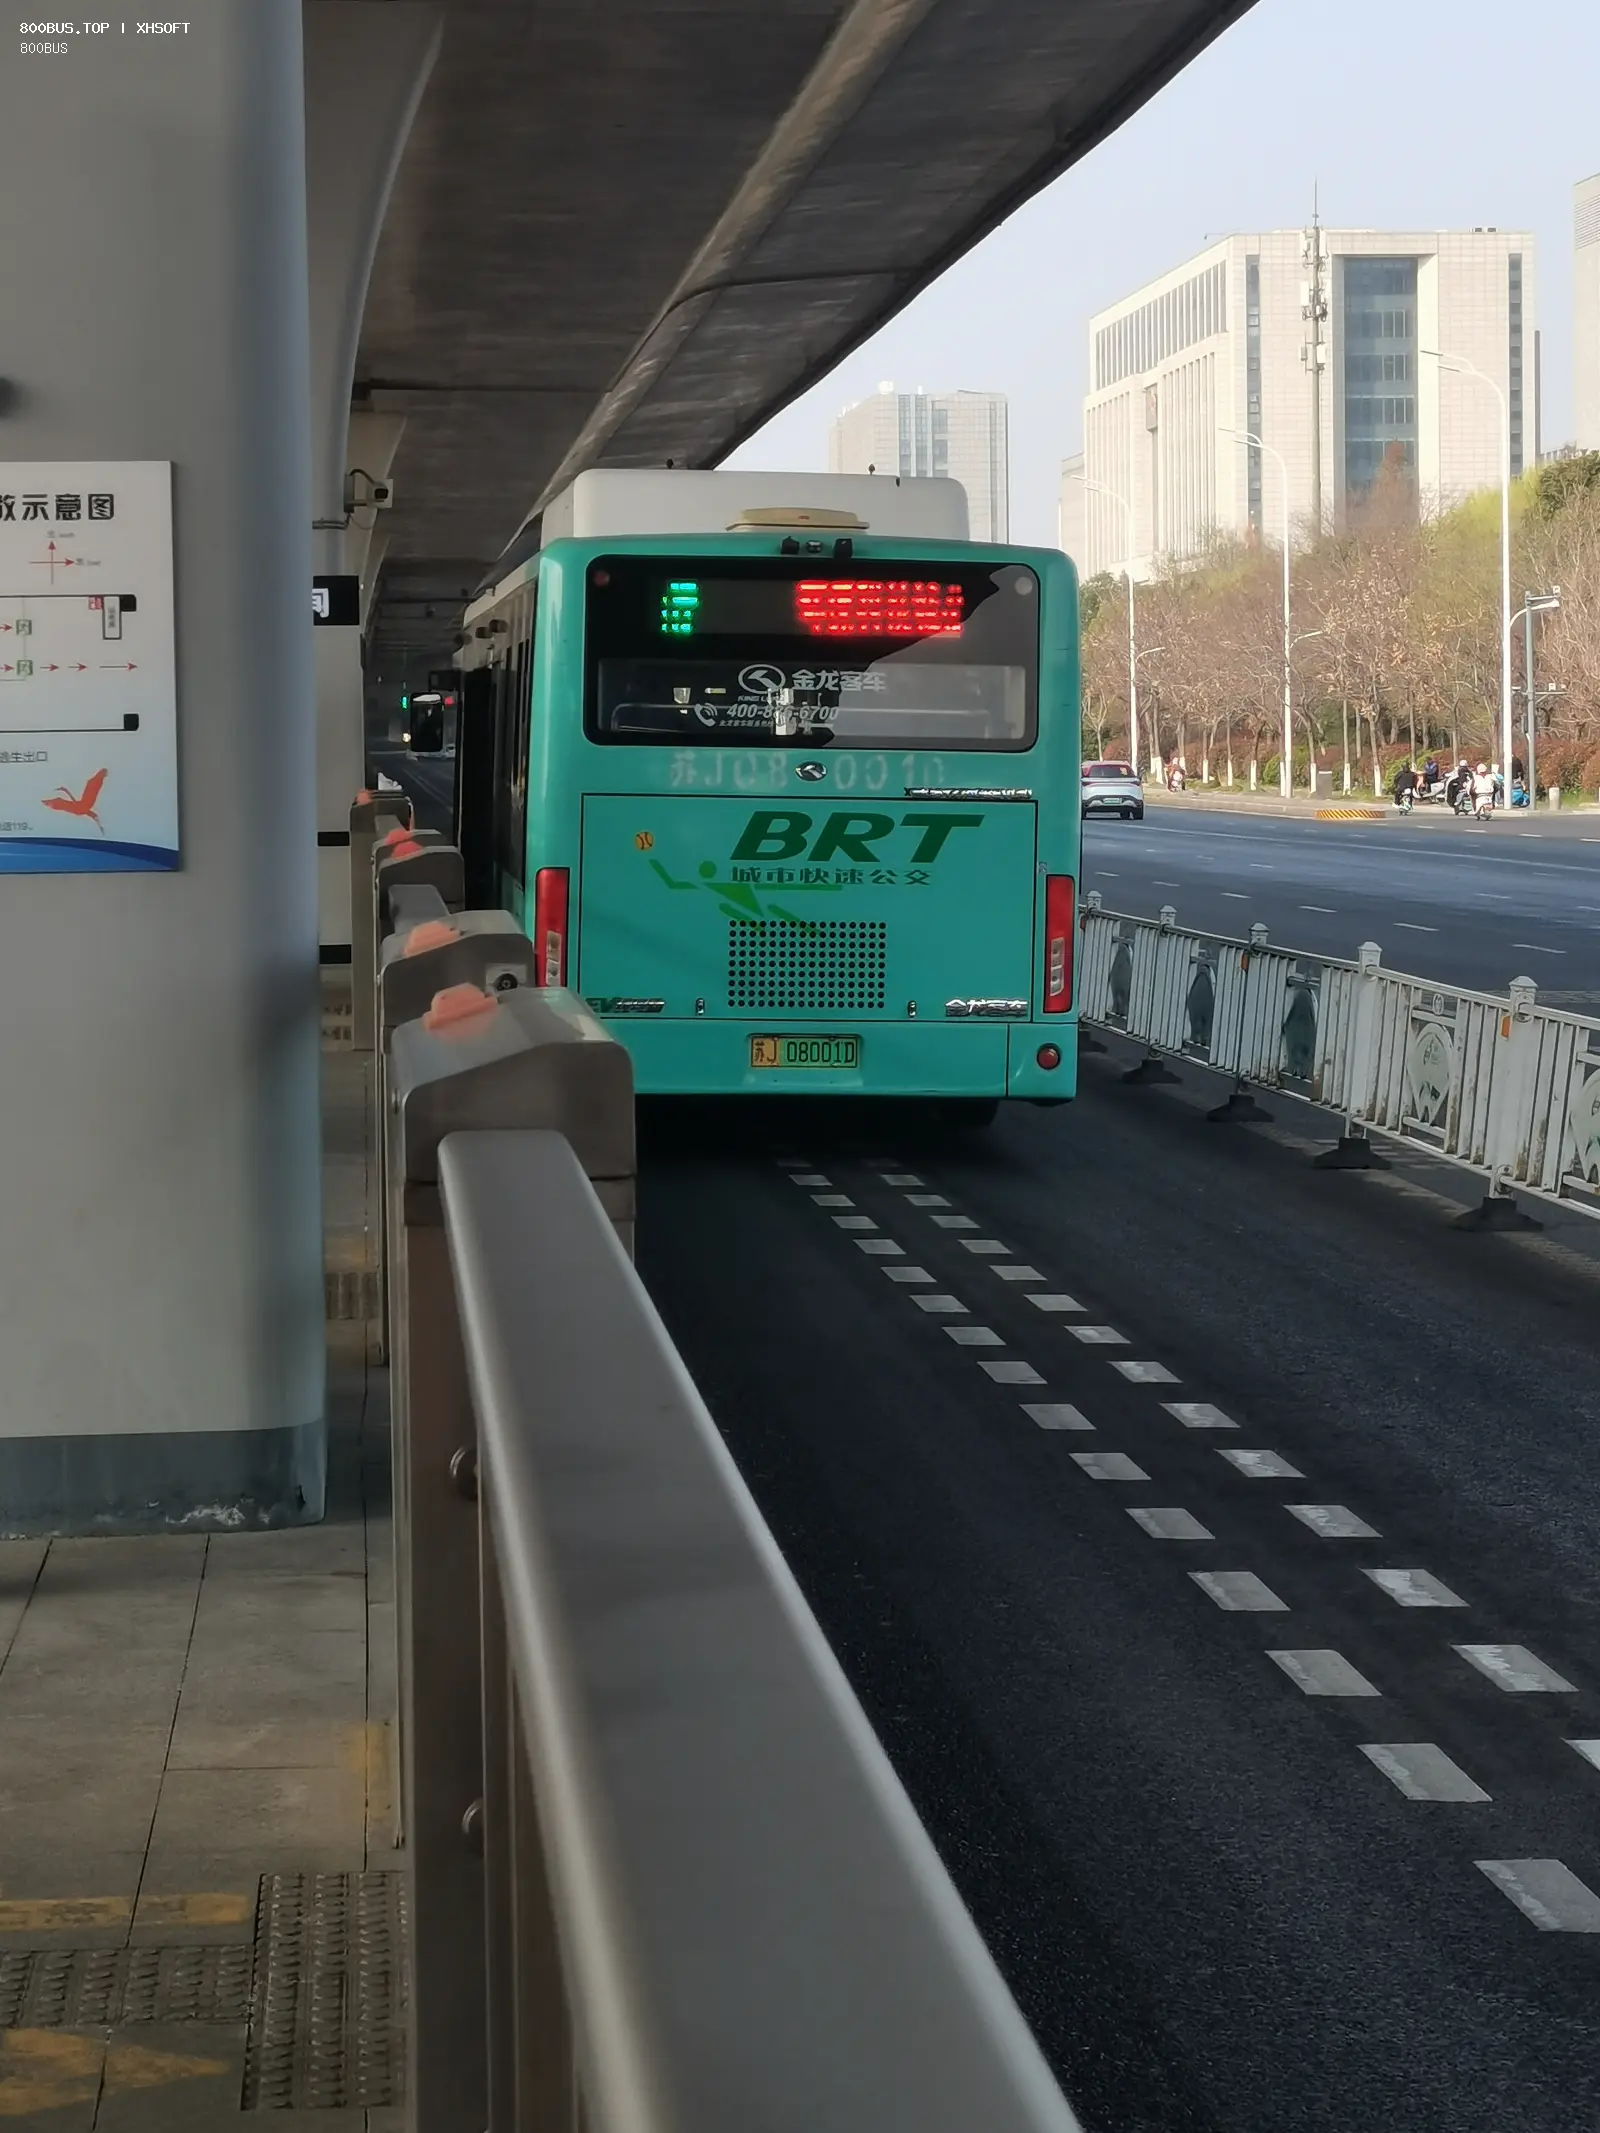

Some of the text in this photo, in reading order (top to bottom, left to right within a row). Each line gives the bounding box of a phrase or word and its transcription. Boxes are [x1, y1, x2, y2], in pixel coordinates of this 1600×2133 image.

[791, 668, 887, 692] 金龙客车
[730, 810, 985, 863] BRT
[730, 866, 931, 885] 城市快速公交
